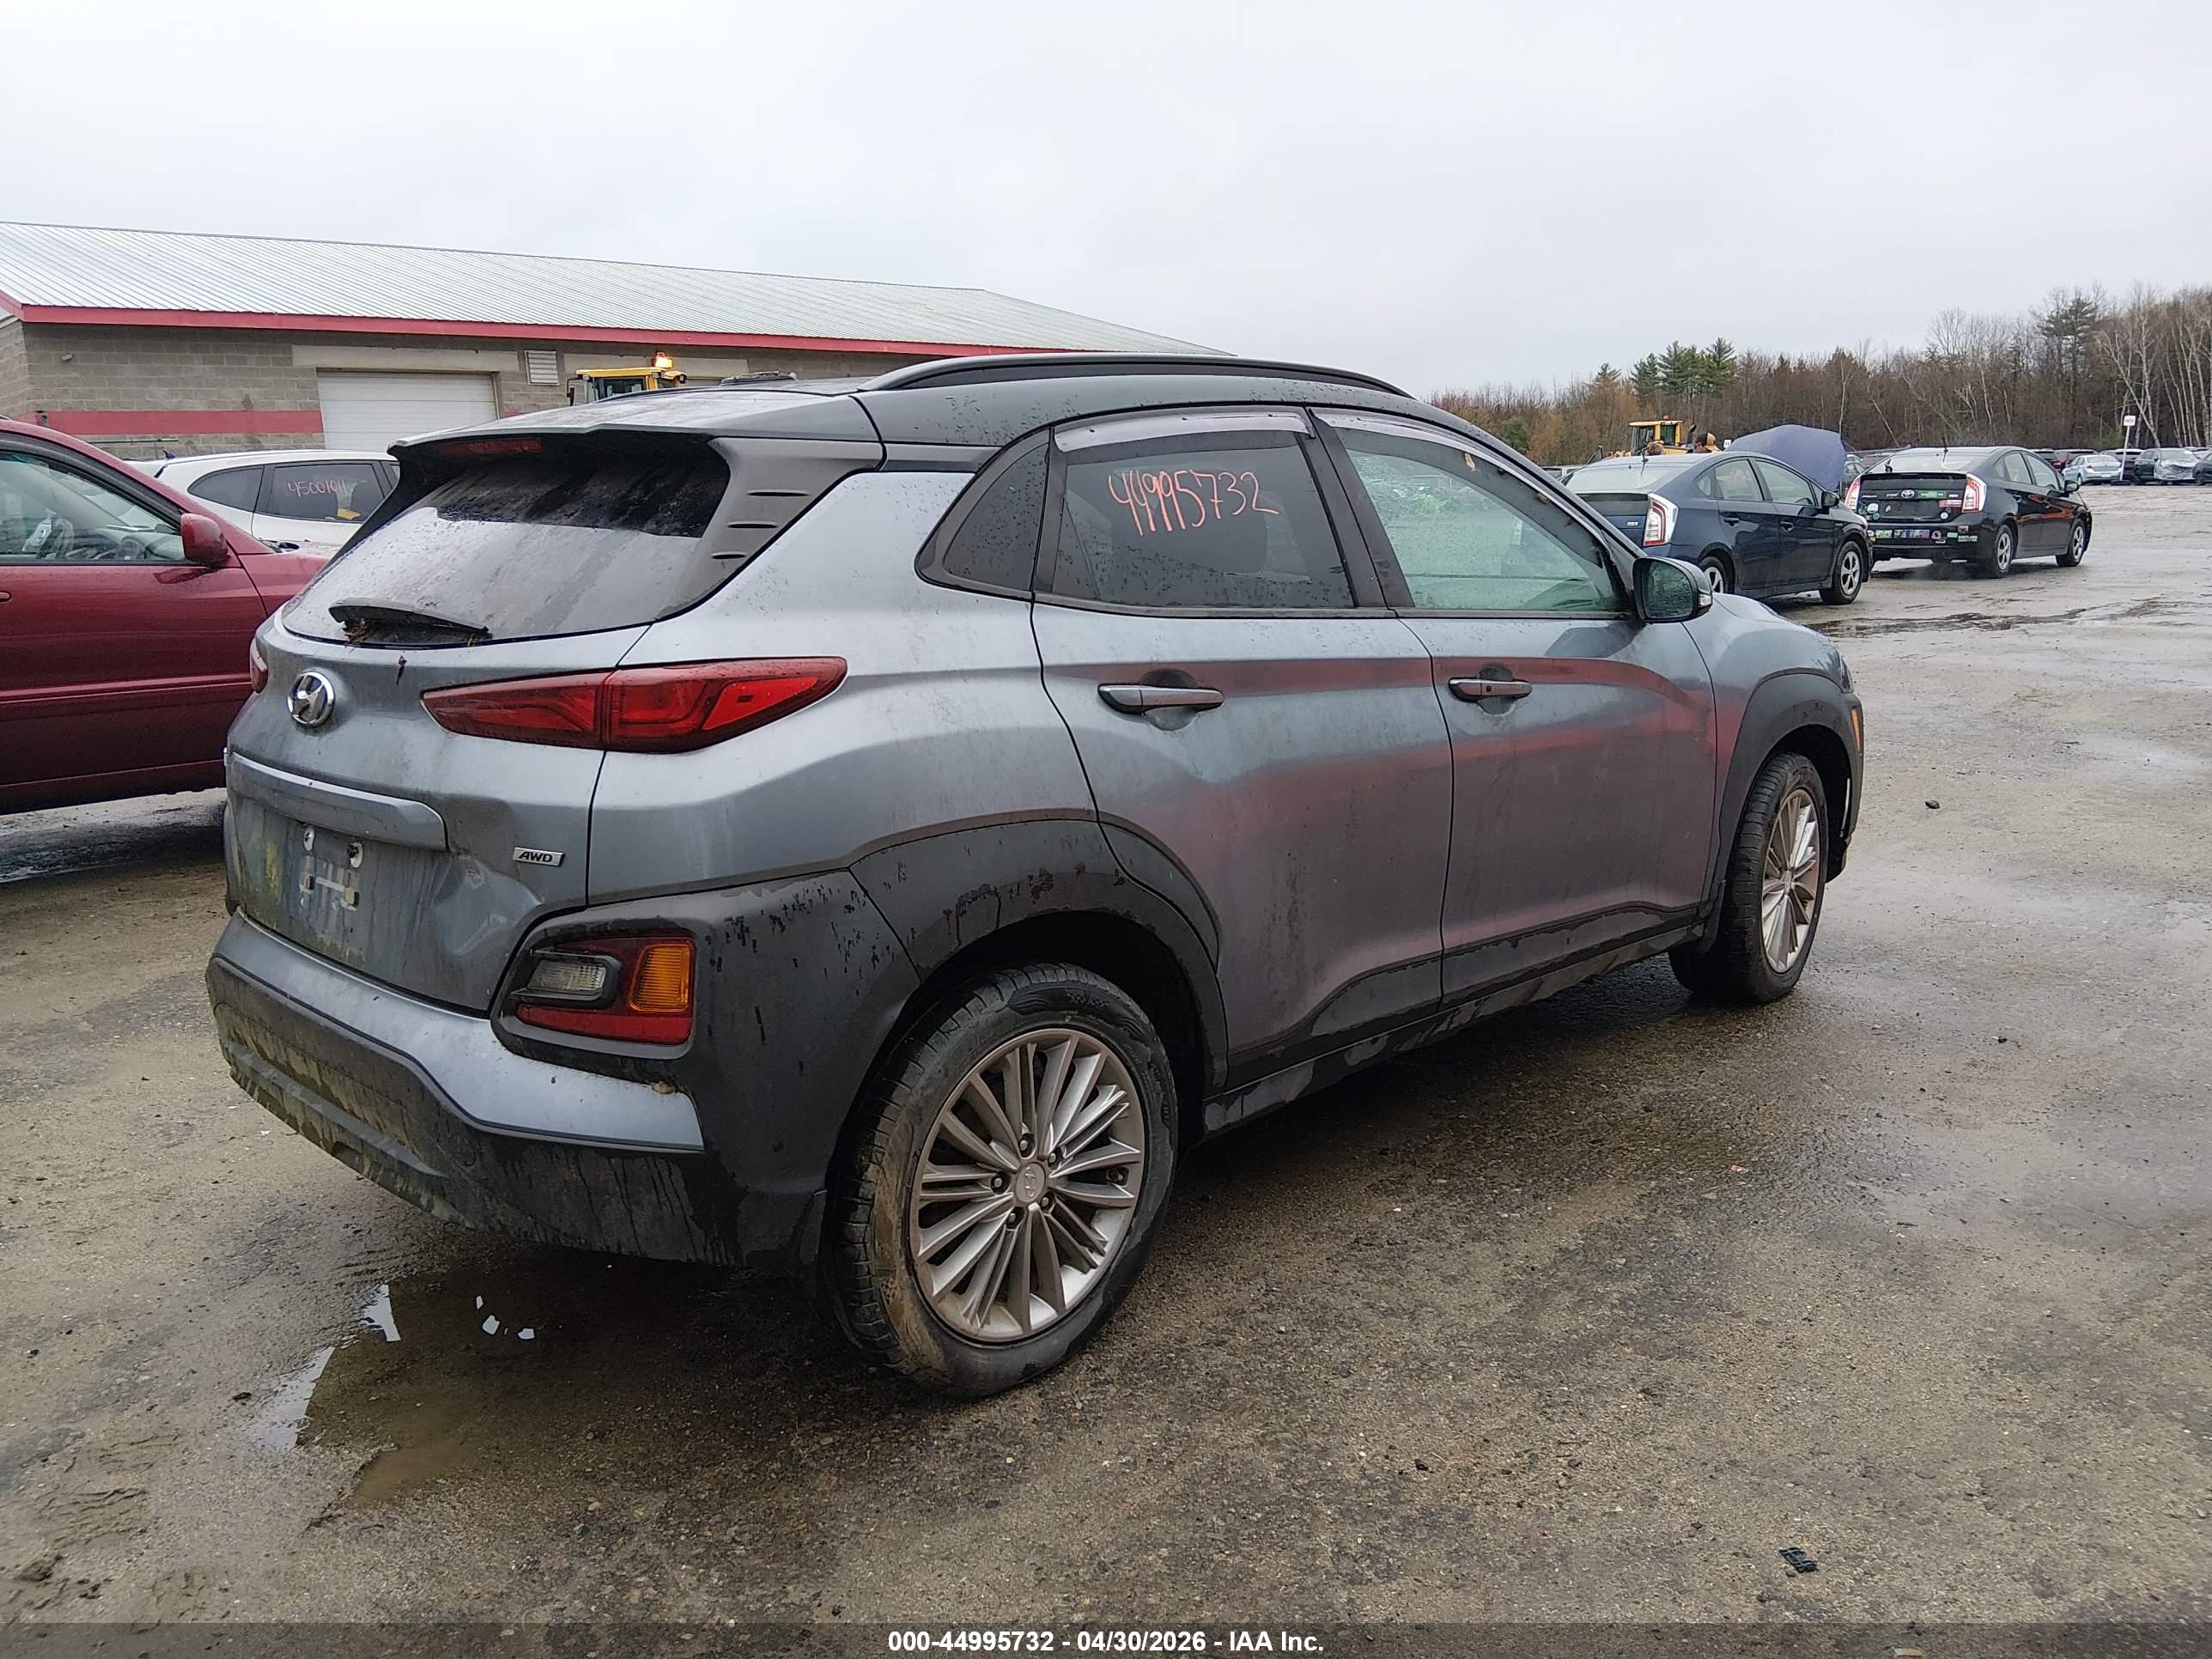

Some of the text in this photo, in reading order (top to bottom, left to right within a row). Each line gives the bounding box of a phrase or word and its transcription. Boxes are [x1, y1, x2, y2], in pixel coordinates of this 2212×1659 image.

[289, 480, 348, 497] 45001011
[1109, 470, 1279, 536] 44995732
[519, 851, 553, 862] AWD
